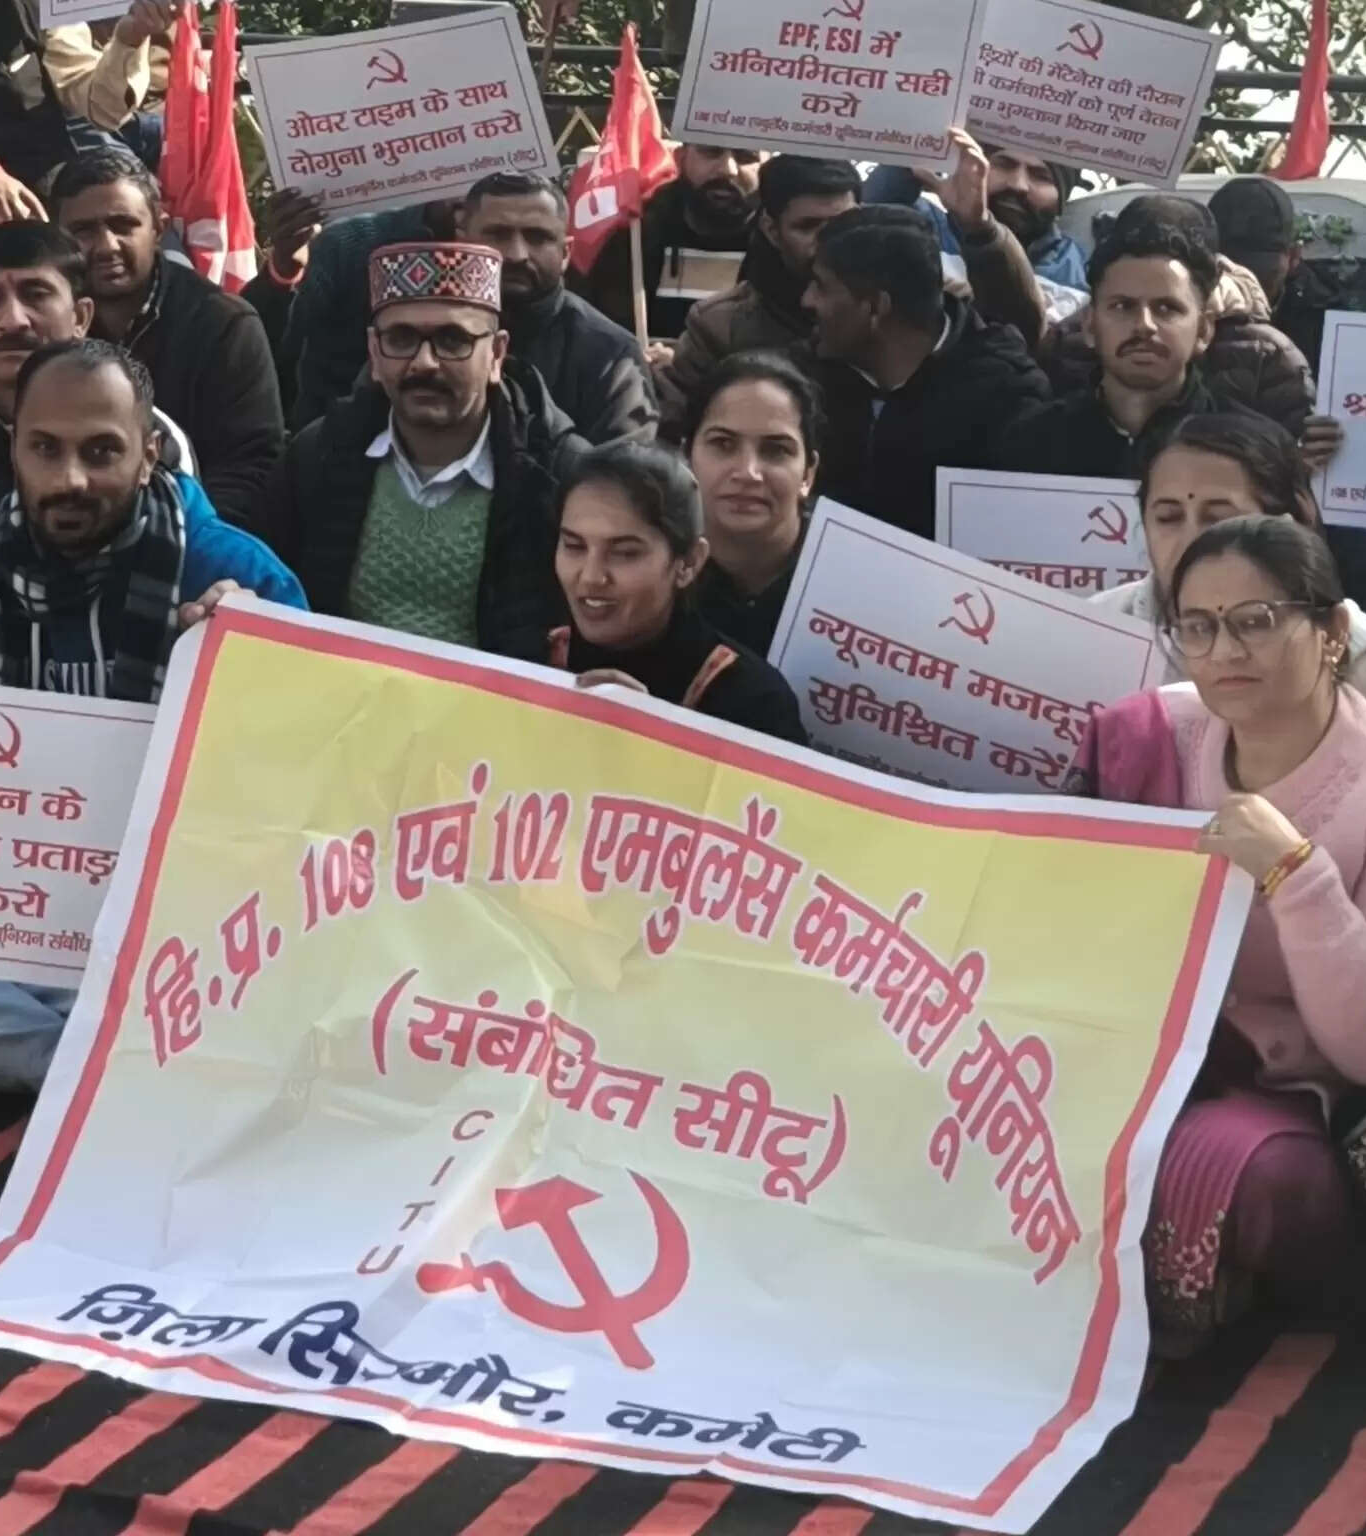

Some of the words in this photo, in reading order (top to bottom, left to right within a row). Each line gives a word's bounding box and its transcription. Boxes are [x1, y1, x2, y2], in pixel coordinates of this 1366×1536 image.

[779, 21, 820, 51] EPF,
[825, 26, 862, 54] ESI
[869, 31, 902, 58] में
[709, 48, 889, 90] अनियमितता
[895, 68, 953, 96] सही
[286, 110, 349, 139] ओवर
[350, 98, 416, 127] टाइम
[420, 88, 449, 113] के
[454, 80, 508, 107] साथ
[801, 92, 862, 118] करो
[287, 144, 367, 178] दोगुना
[372, 124, 466, 166] भुगतान
[471, 109, 523, 139] करो
[809, 608, 960, 690] न्यूनतम
[967, 669, 1104, 744] मजदू
[809, 676, 980, 761] सुनिश्चित
[989, 741, 1067, 789] करें
[41, 786, 88, 821] के
[11, 838, 119, 886] प्रताड़
[48, 929, 90, 954] संबंधि
[300, 828, 376, 933] 108
[395, 763, 489, 901] एवं
[488, 792, 570, 881] 102
[580, 796, 803, 955] एमबुलेंस
[793, 873, 985, 1068] कर्मचारी
[929, 1019, 1082, 1286] यूनियन
[372, 967, 664, 1130] (संबंधित
[673, 1070, 847, 1204] सीटू)
[356, 1110, 494, 1275] CITU
[606, 1400, 867, 1463] कमेटी
